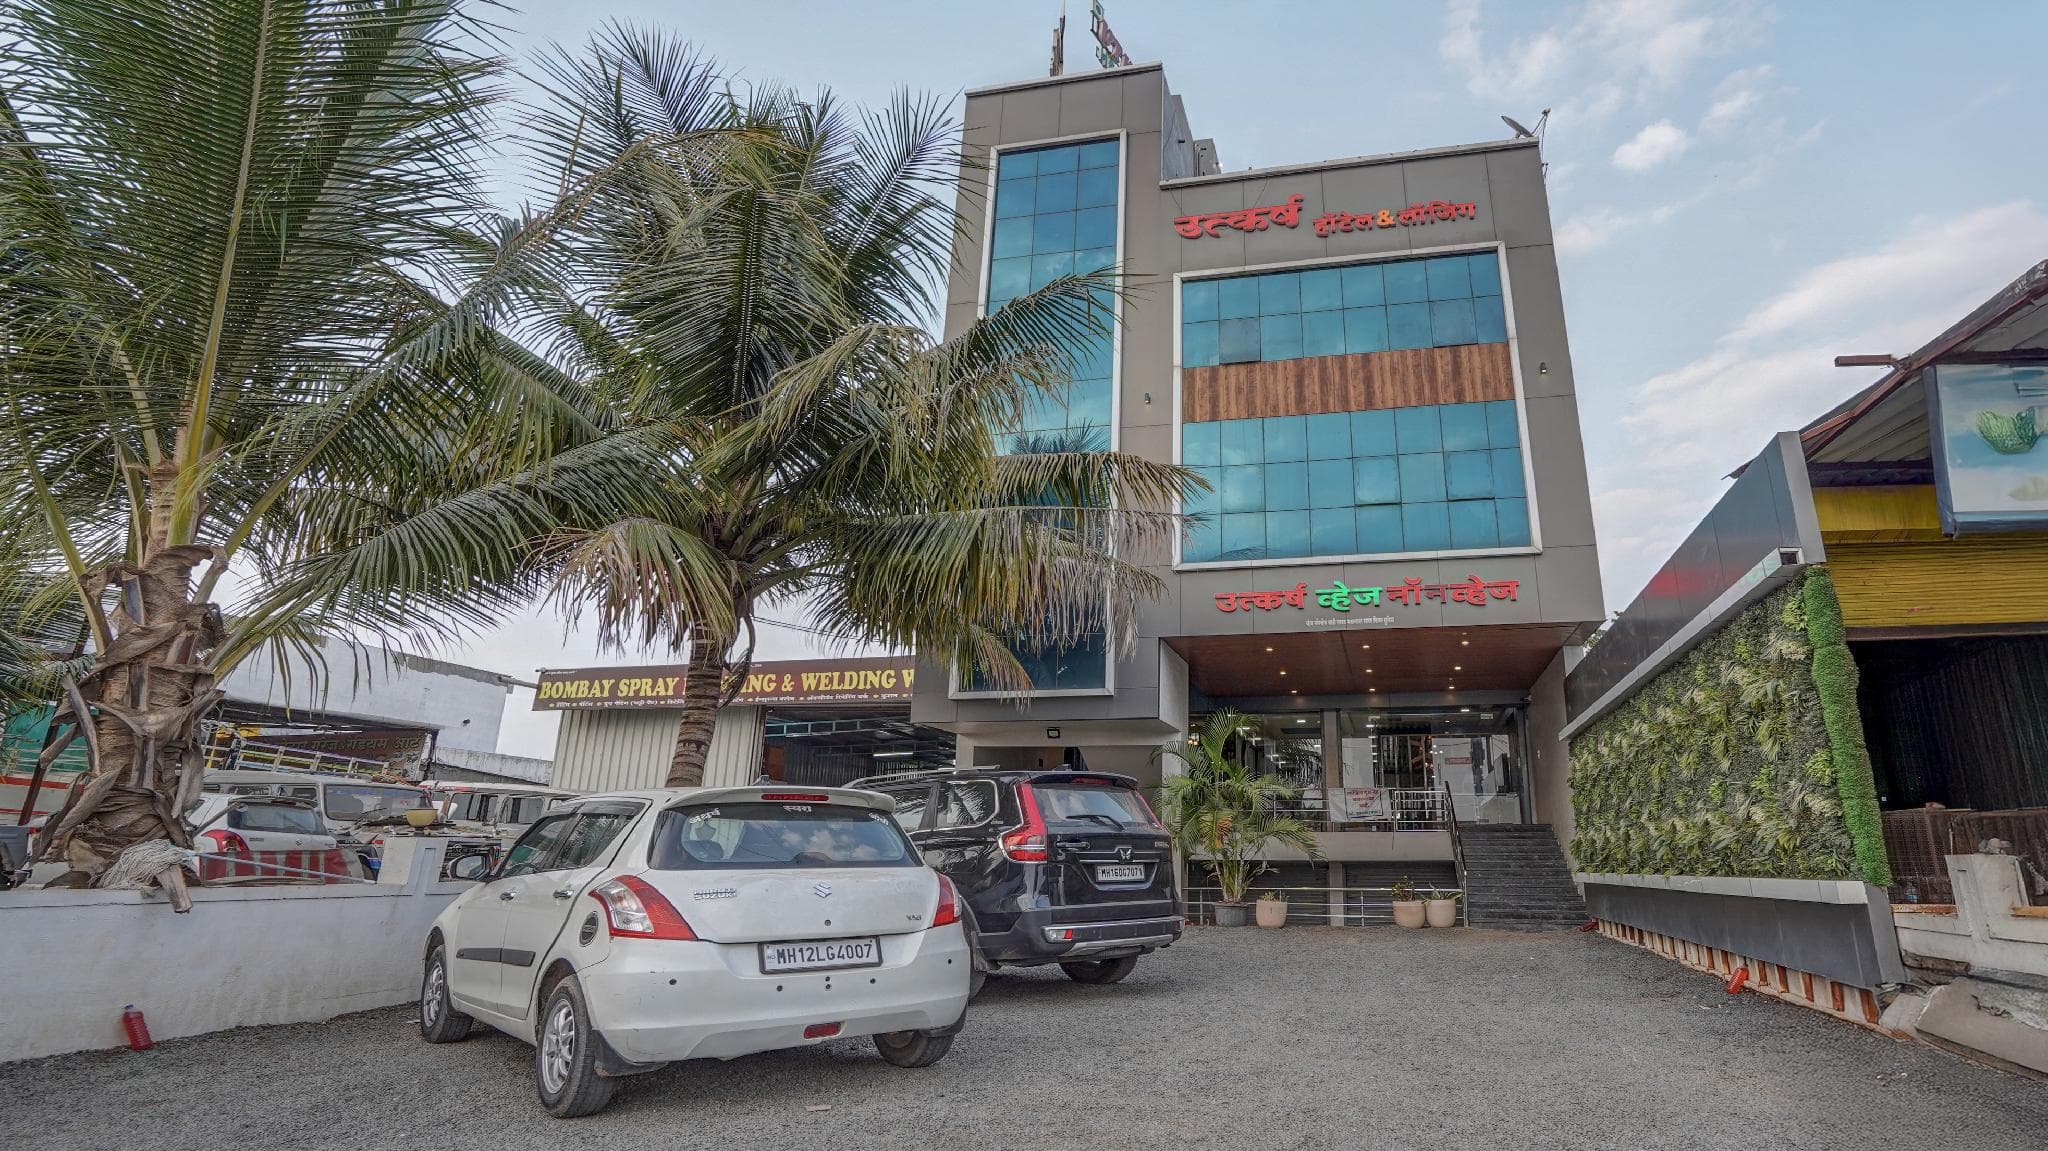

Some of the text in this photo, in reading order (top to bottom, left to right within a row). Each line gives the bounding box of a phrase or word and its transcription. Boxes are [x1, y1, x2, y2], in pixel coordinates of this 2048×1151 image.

[1173, 193, 1304, 239] उत्कर्ष
[1376, 208, 1396, 228] &
[1214, 582, 1308, 612] उत्कर्ष
[1314, 580, 1383, 612] व्हेज
[539, 679, 614, 699] BOMBAY
[617, 677, 679, 697] SPRAY
[781, 674, 794, 692] &
[801, 669, 896, 691] WELDING
[777, 943, 872, 964] MH12LG4007
